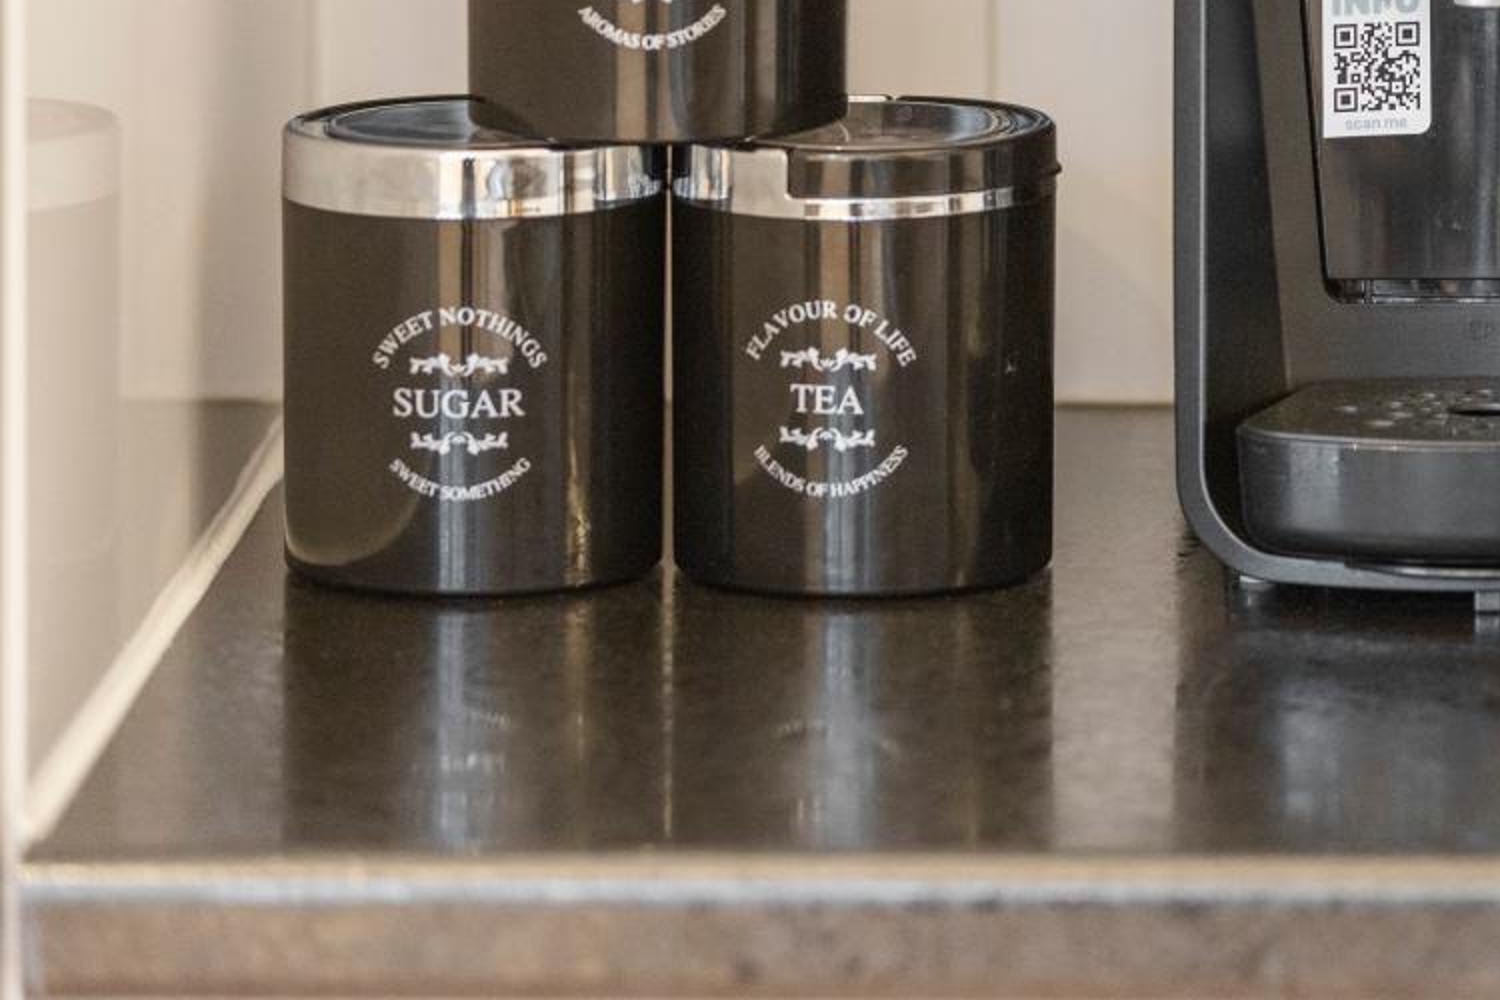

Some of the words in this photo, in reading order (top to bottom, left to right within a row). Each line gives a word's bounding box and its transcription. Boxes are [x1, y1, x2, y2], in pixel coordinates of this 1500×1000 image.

[577, 5, 642, 50] AROMAS
[641, 34, 668, 51] OF
[665, 3, 728, 48] STORIES
[1345, 121, 1381, 131] scan
[1384, 117, 1408, 129] me
[372, 311, 433, 370] SWEET
[437, 306, 548, 369] NOTHINGS
[746, 299, 838, 361] FLAVOUR
[842, 303, 878, 329] OF
[872, 318, 918, 368] LIFE
[392, 387, 526, 418] SUGAR
[789, 383, 865, 415] TEA
[388, 457, 441, 497] SWEET
[753, 444, 805, 493] BLENDS
[805, 480, 830, 498] OF
[829, 443, 909, 498] HAPPINESS
